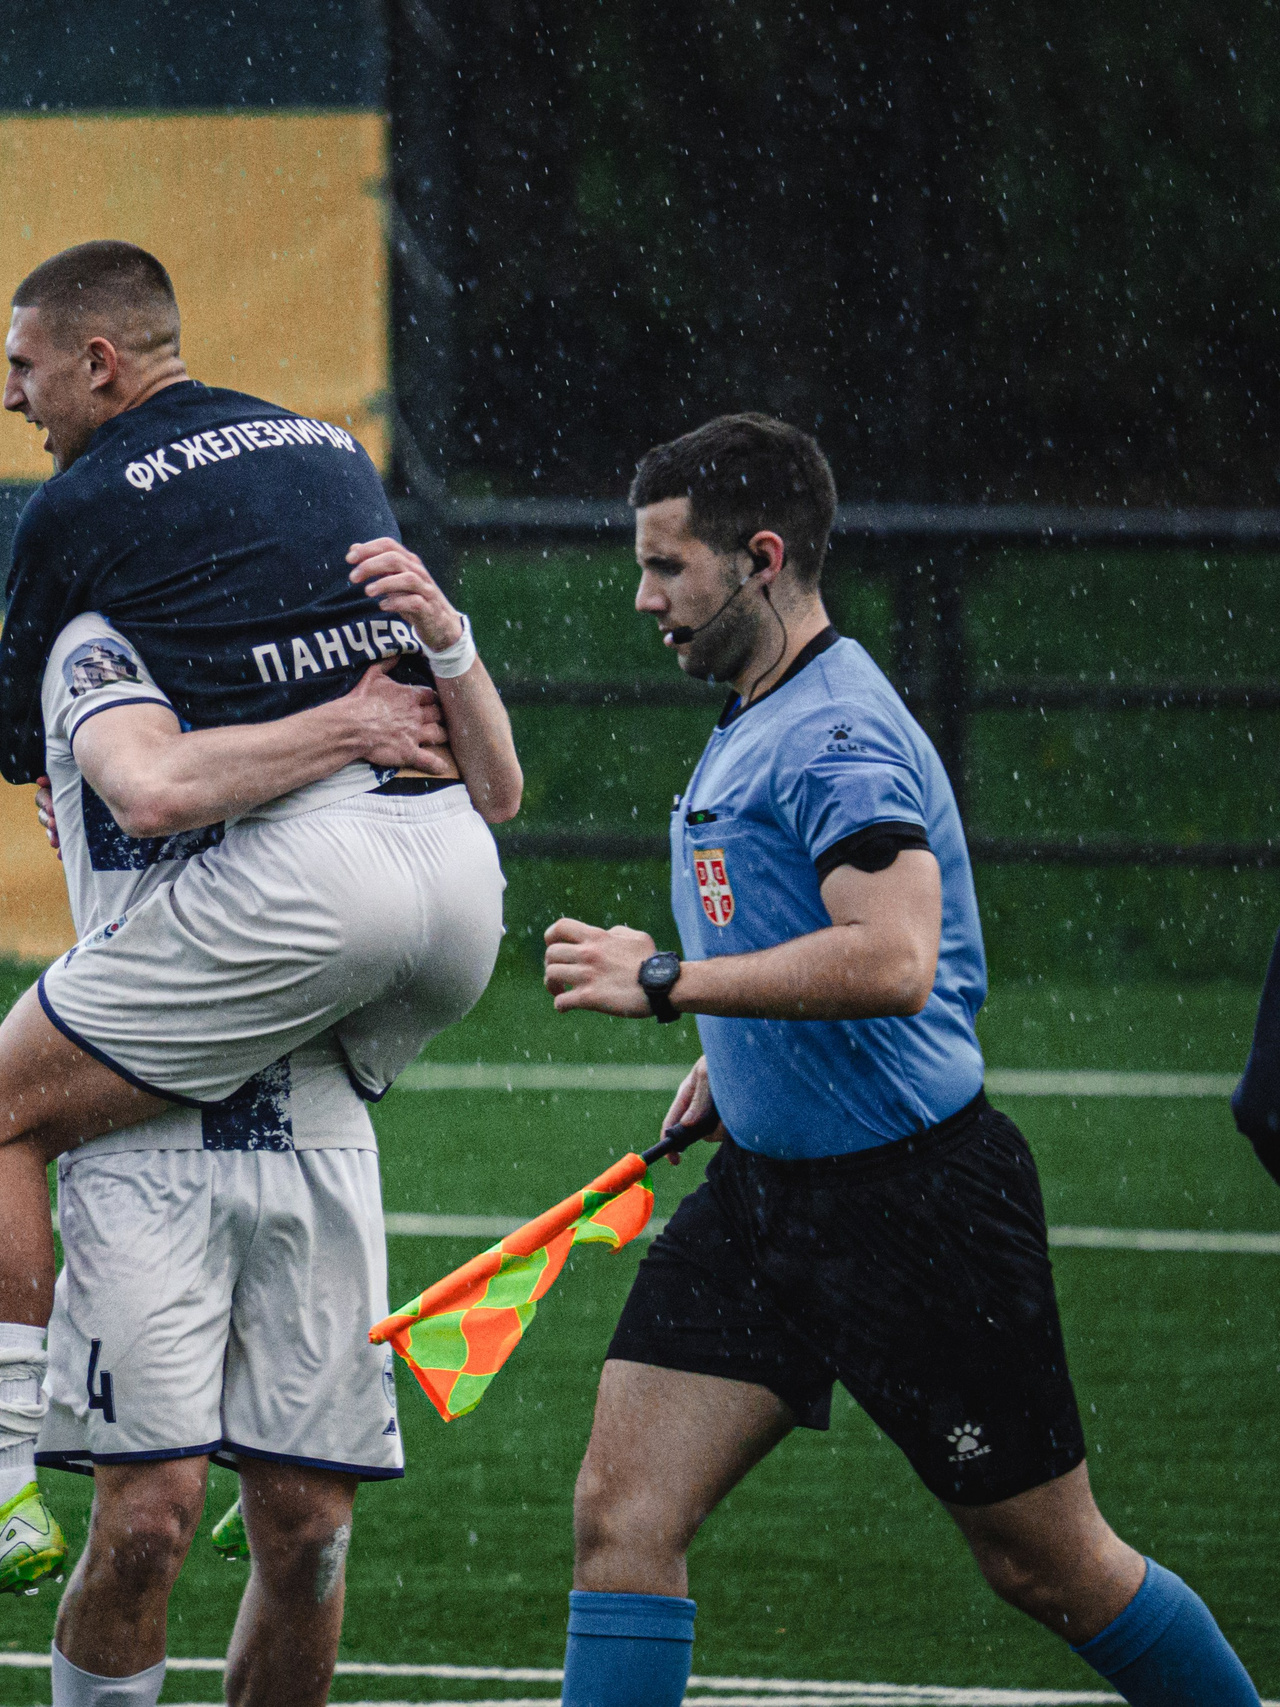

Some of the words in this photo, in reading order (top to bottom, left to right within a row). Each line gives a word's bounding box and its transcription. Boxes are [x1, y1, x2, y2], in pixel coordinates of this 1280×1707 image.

[124, 448, 182, 491] ФК
[170, 418, 357, 470] ЖЕЛЕЗНИЧАР
[819, 743, 868, 754] ELME
[87, 1337, 116, 1423] 4
[948, 1445, 992, 1462] KELME
